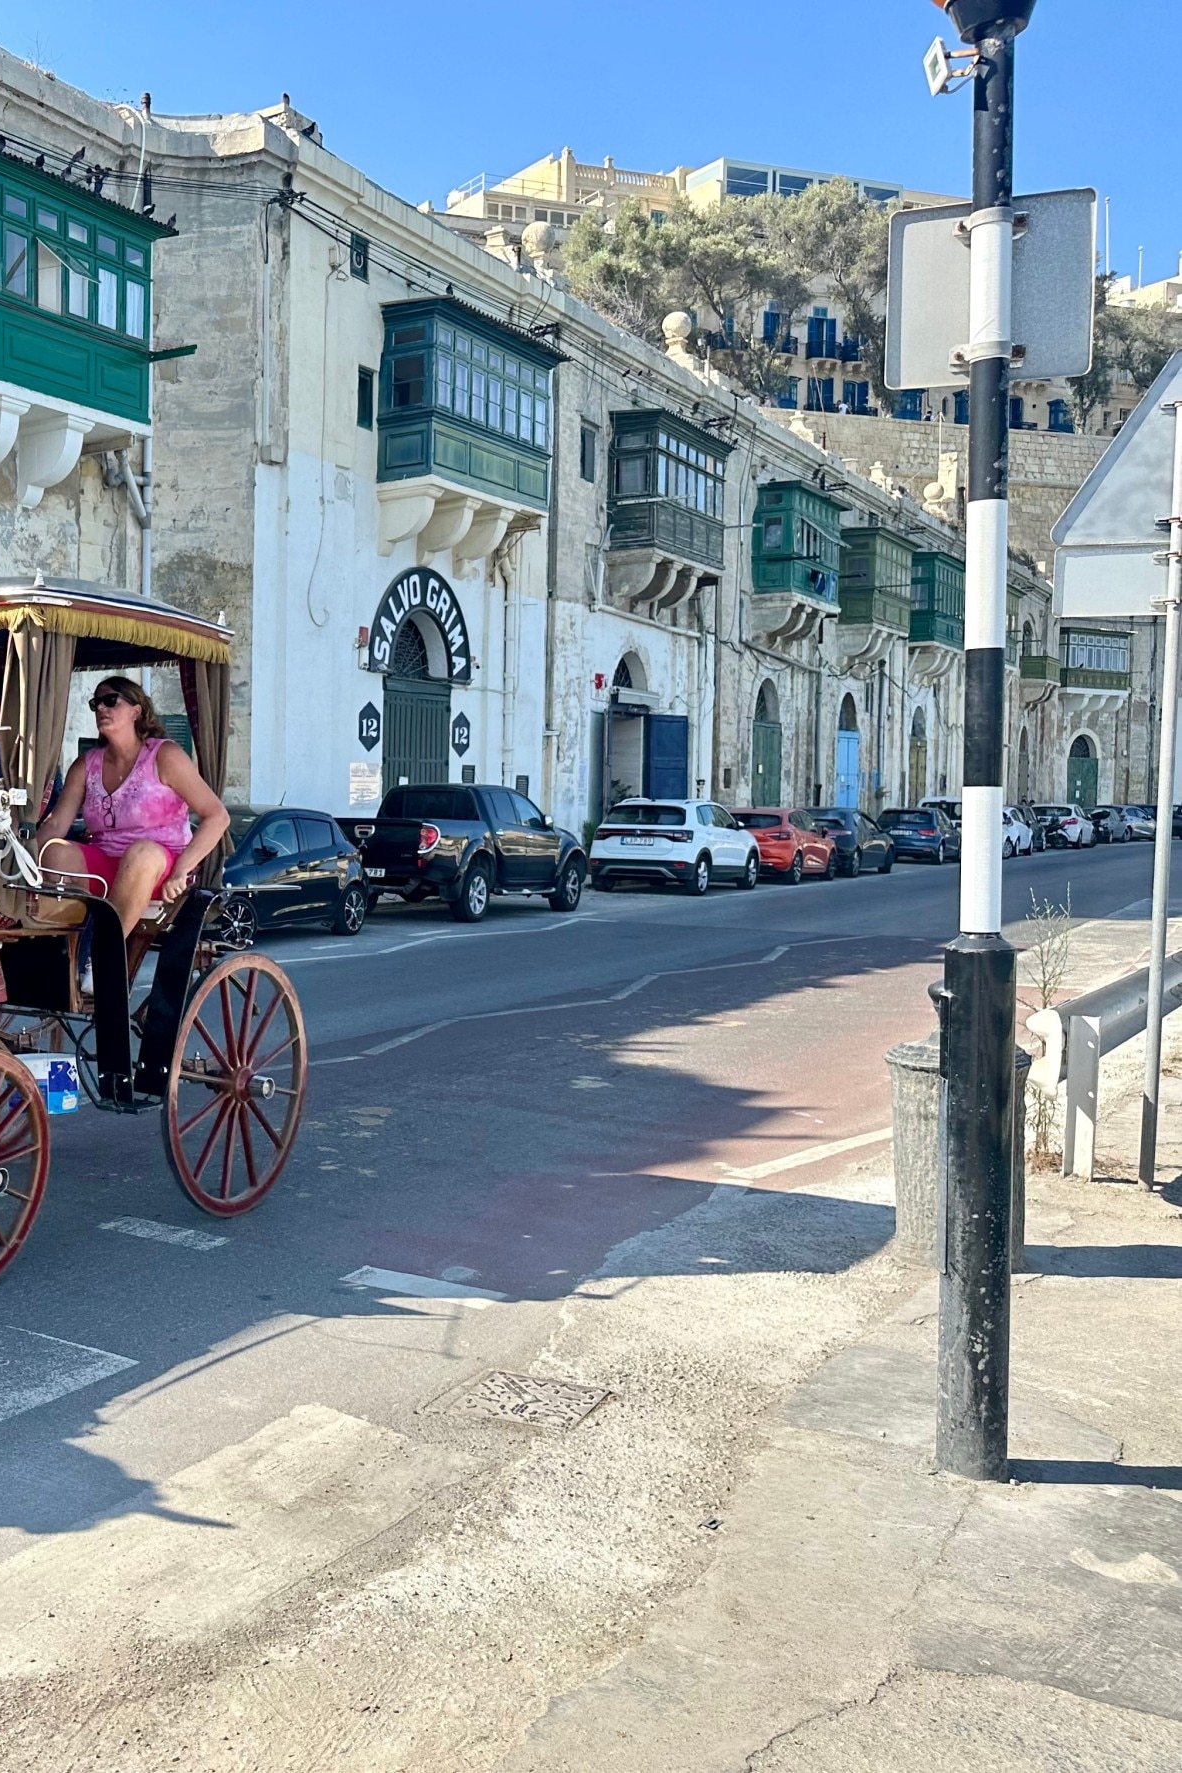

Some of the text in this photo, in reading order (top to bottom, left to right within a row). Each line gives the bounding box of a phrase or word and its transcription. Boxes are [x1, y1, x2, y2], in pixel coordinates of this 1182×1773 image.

[375, 574, 467, 677] SALVO GRIMA
[362, 718, 378, 737] 12
[454, 727, 468, 744] 12
